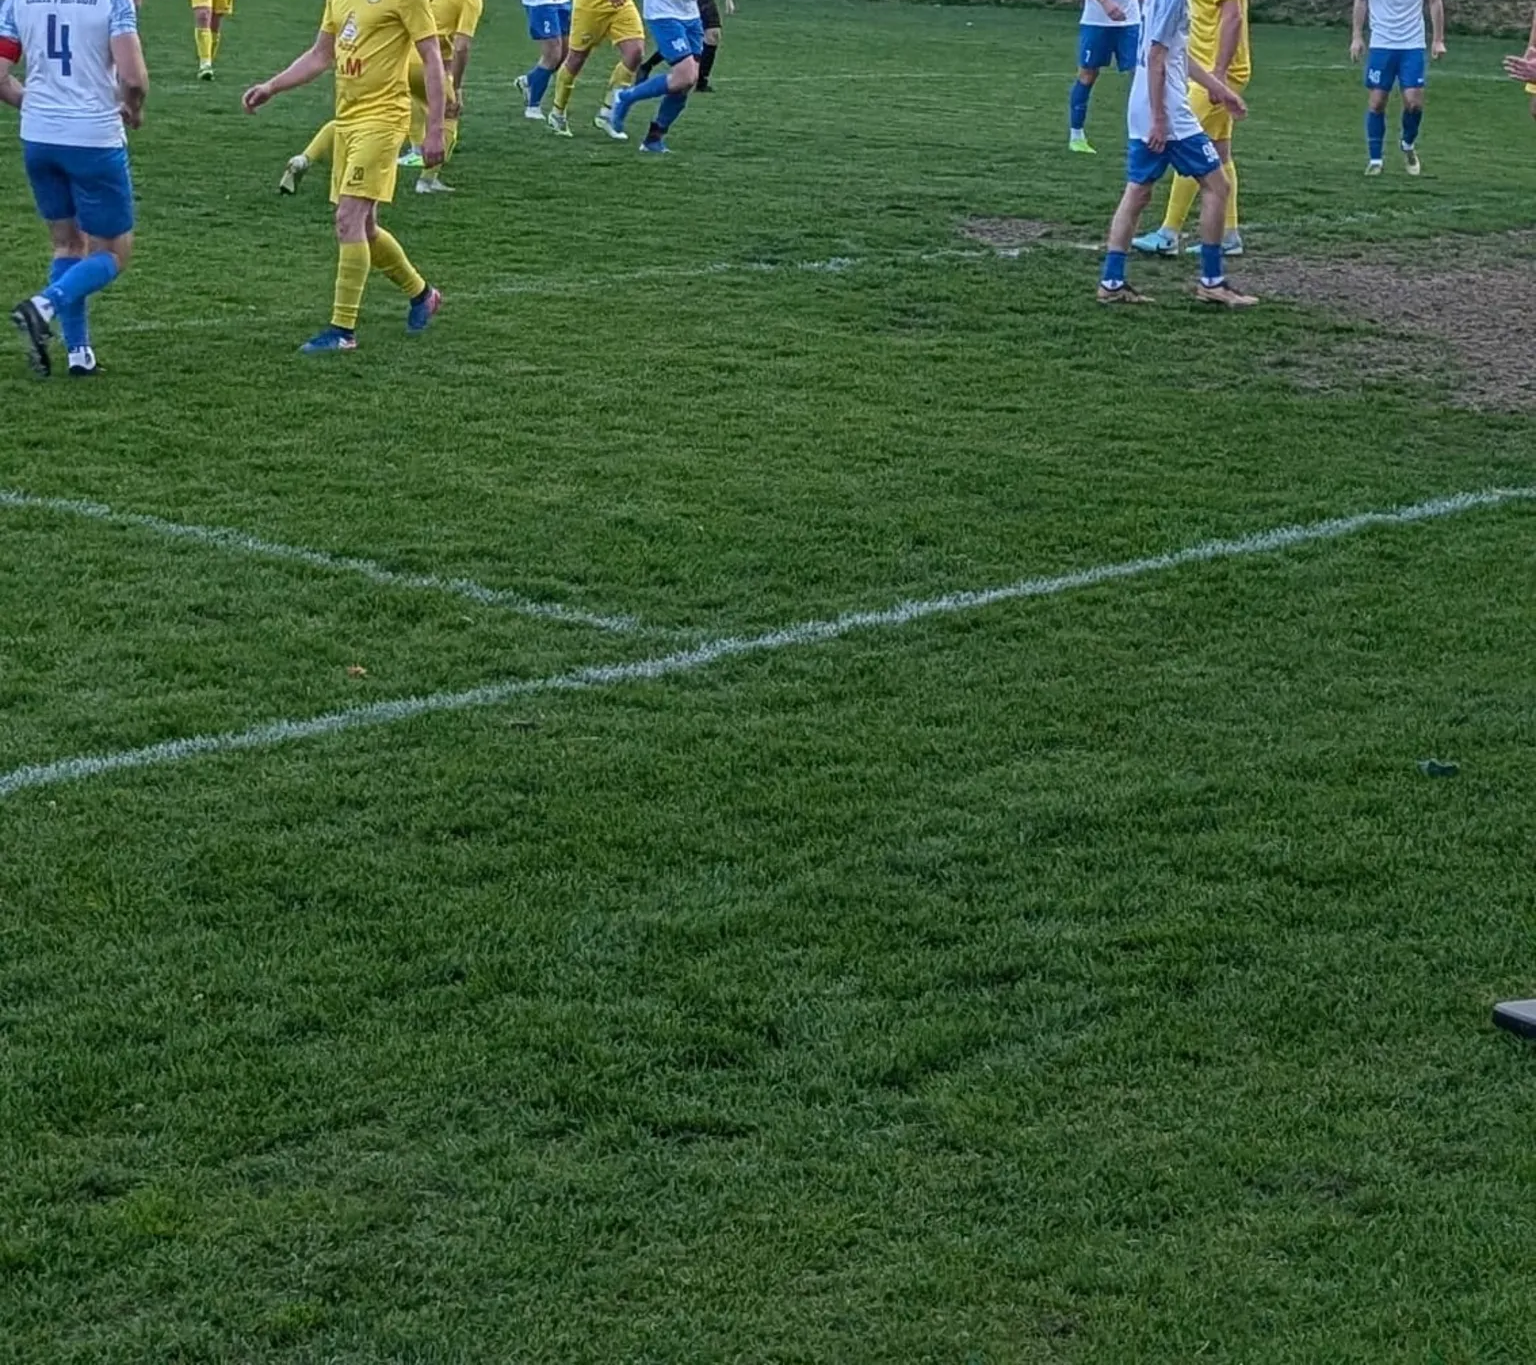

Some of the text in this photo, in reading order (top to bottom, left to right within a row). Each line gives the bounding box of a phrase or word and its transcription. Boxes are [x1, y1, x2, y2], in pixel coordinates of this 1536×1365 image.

[543, 21, 550, 33] 2
[47, 14, 72, 76] 4
[1085, 50, 1091, 63] 7
